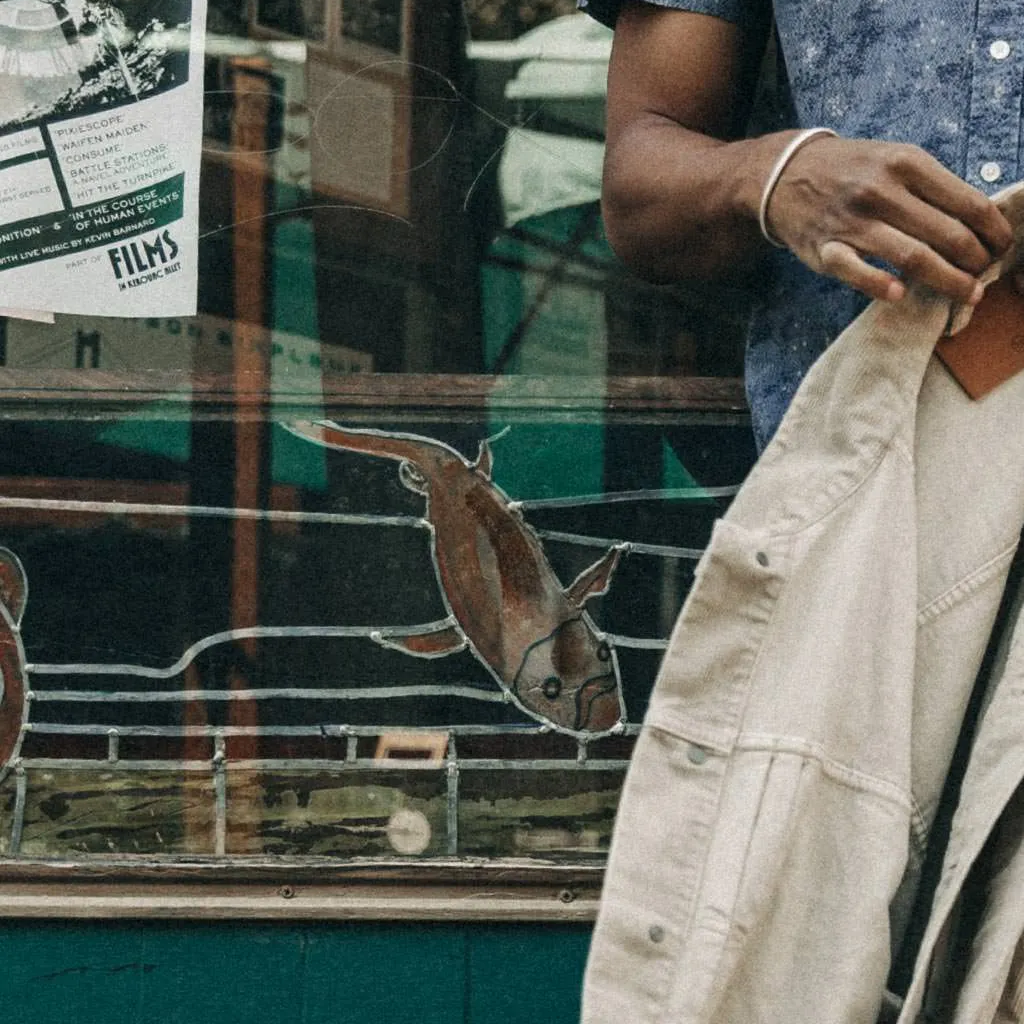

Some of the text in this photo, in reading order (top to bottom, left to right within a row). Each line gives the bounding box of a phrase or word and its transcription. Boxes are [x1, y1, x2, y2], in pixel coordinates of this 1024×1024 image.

[87, 205, 110, 218] THE
[111, 188, 158, 212] COURSE
[75, 220, 91, 231] OF
[94, 209, 135, 227] HUMAN
[20, 249, 41, 261] LIVE
[42, 241, 69, 256] MUSIC
[71, 238, 83, 248] BY
[85, 231, 112, 245] KEVIN
[112, 217, 156, 236] BARNARD
[107, 228, 179, 280] FILMS
[65, 257, 89, 270] PART
